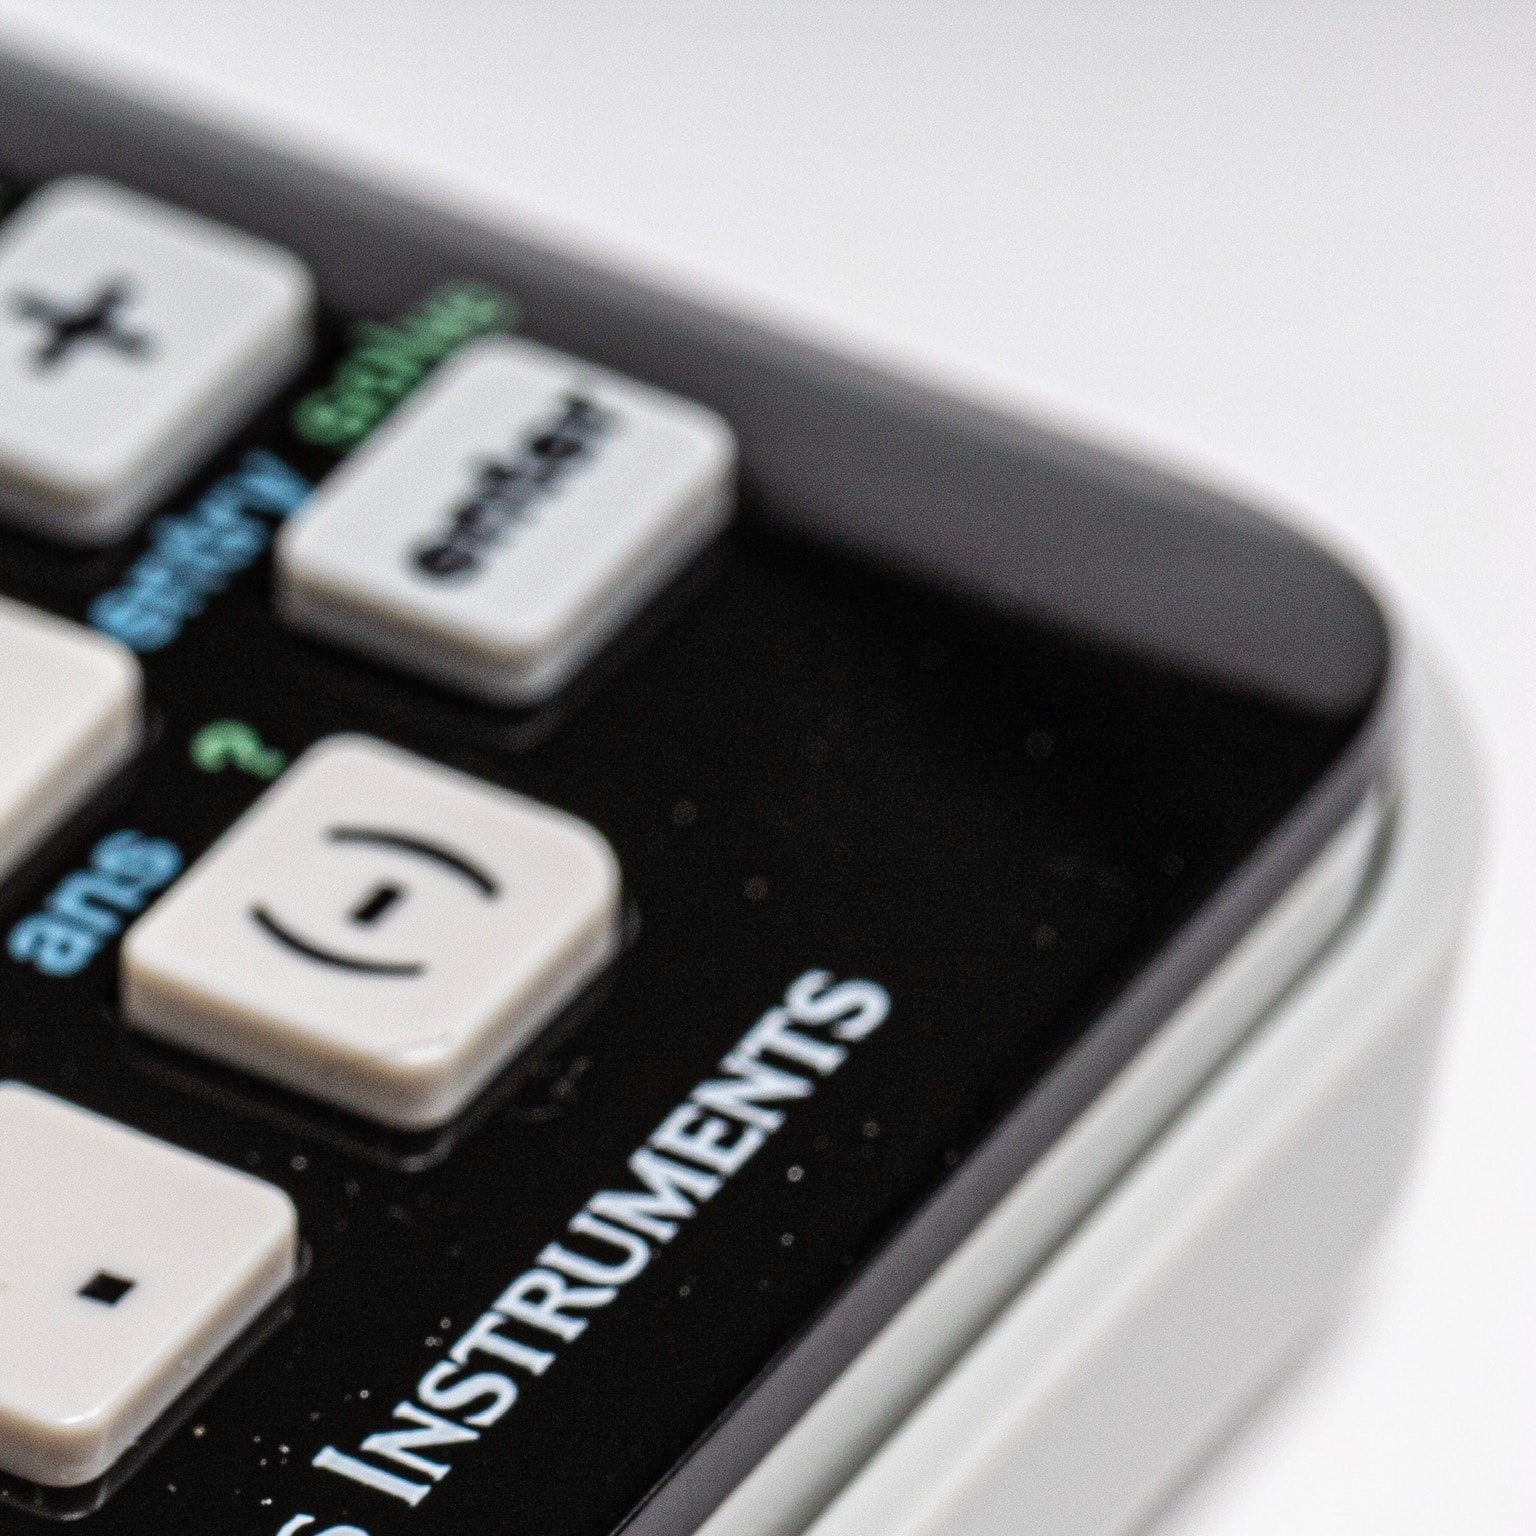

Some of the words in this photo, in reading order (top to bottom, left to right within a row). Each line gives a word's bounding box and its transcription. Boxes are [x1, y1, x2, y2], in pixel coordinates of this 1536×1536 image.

[406, 385, 618, 584] enter
[192, 722, 284, 779] ?
[10, 830, 182, 974] ans
[312, 970, 892, 1508] INSTRUMENTS
